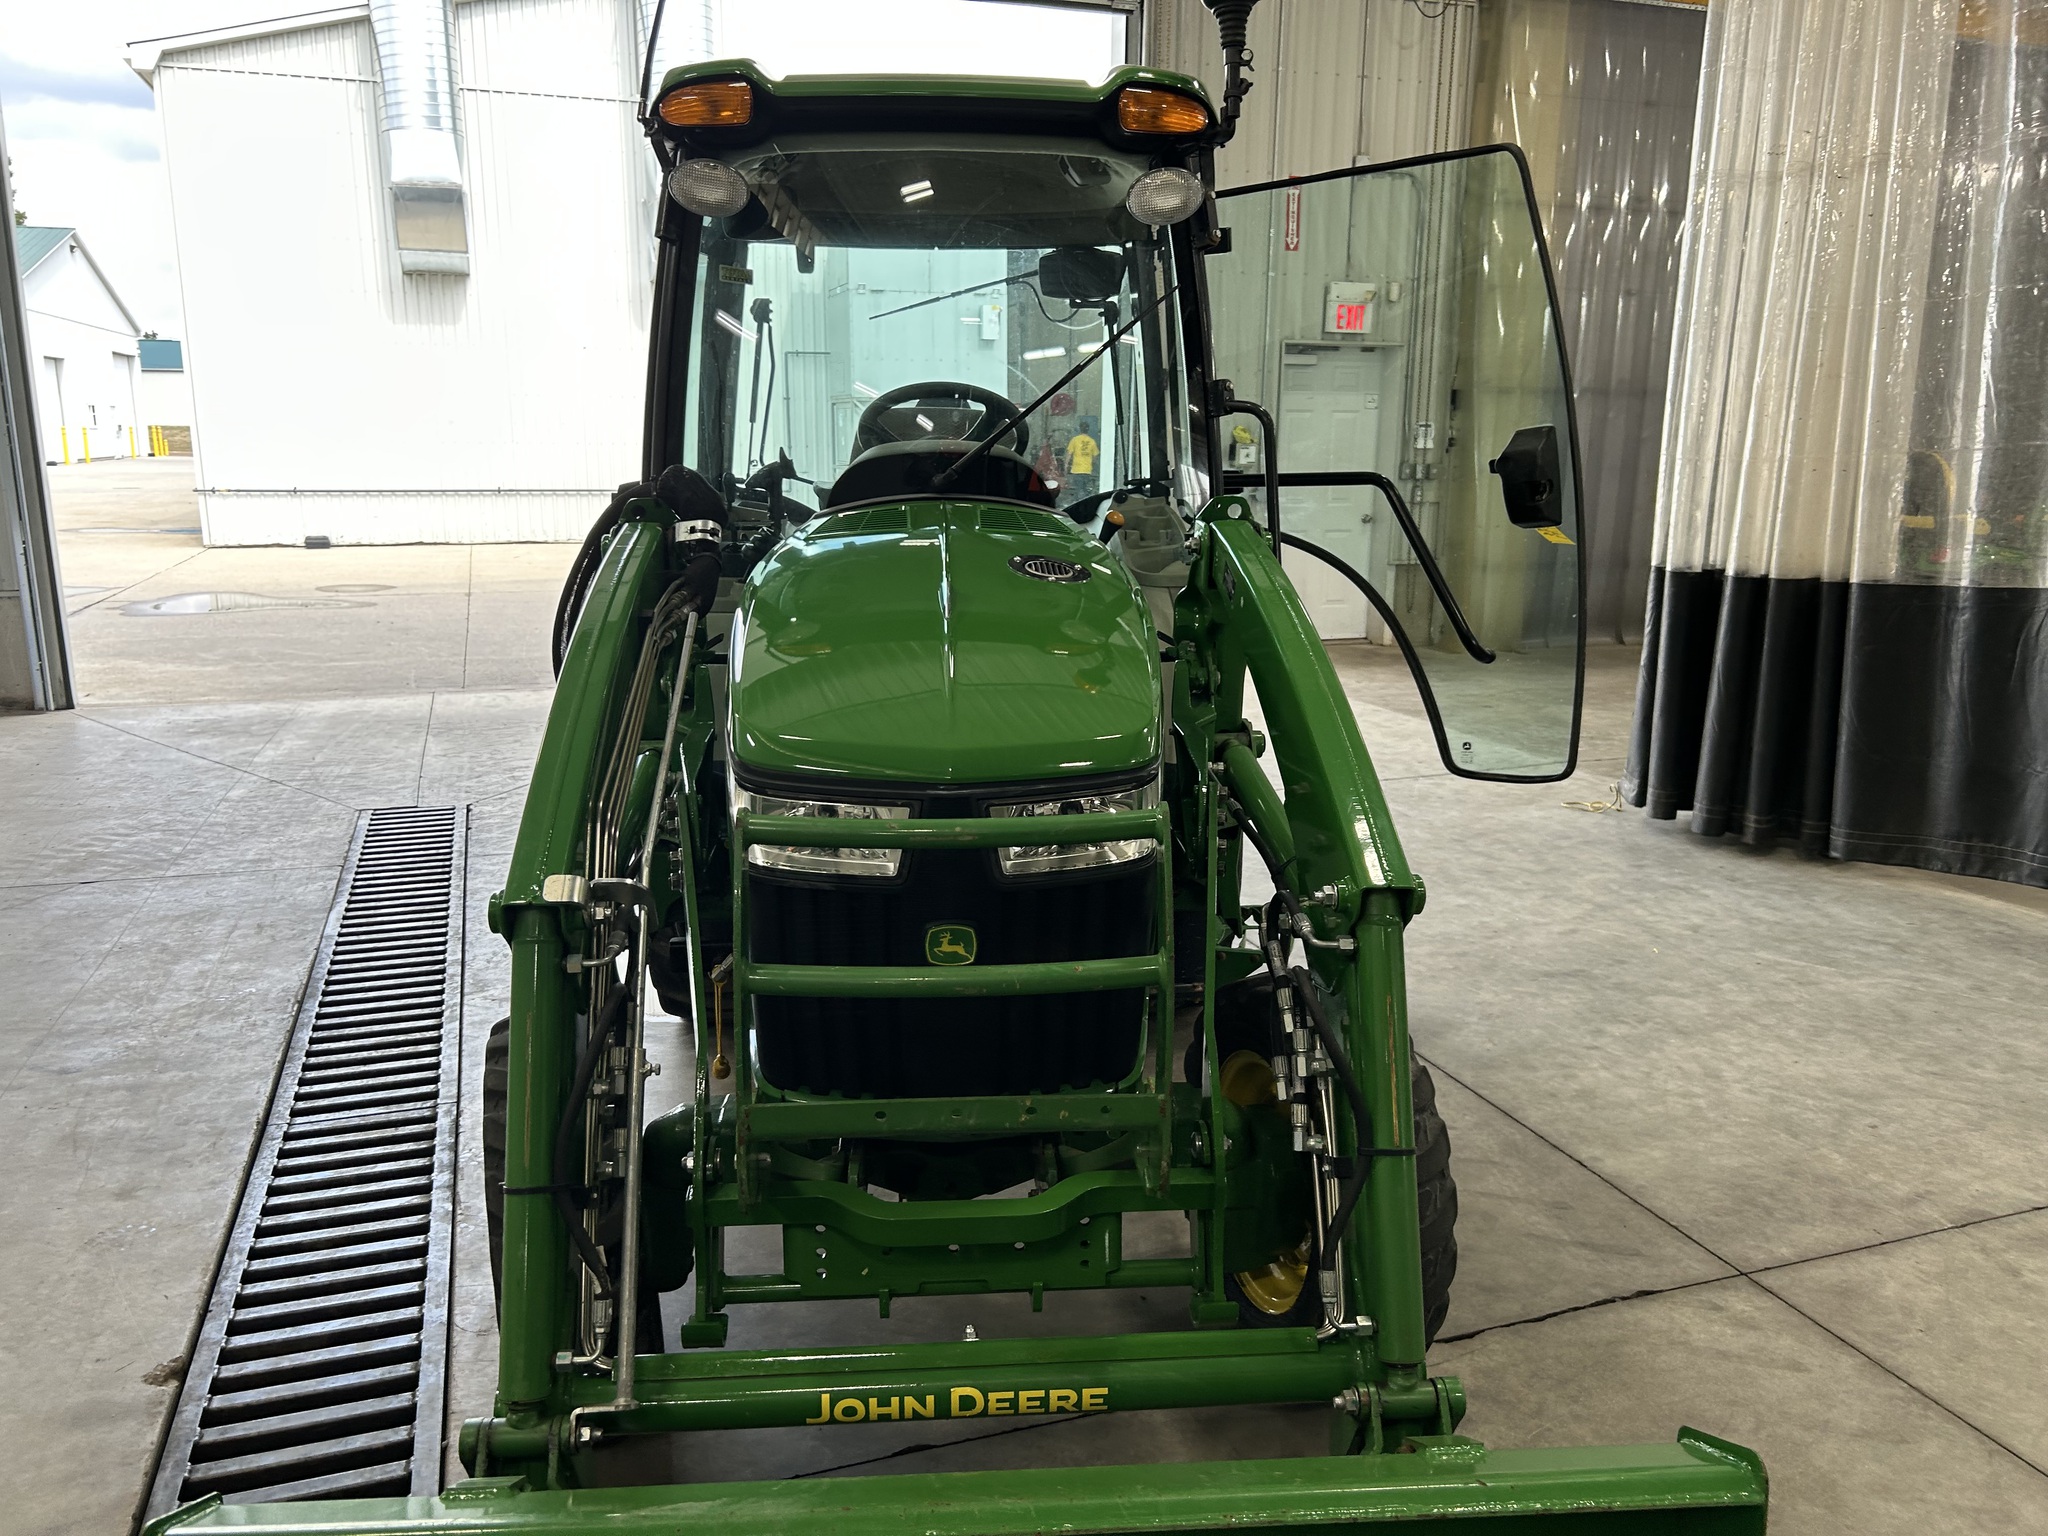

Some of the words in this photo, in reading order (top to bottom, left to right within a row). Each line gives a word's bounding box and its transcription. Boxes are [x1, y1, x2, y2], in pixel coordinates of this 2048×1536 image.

[1336, 304, 1366, 330] EXIT
[806, 1393, 935, 1424] JOHN
[951, 1387, 1108, 1417] DEERE
